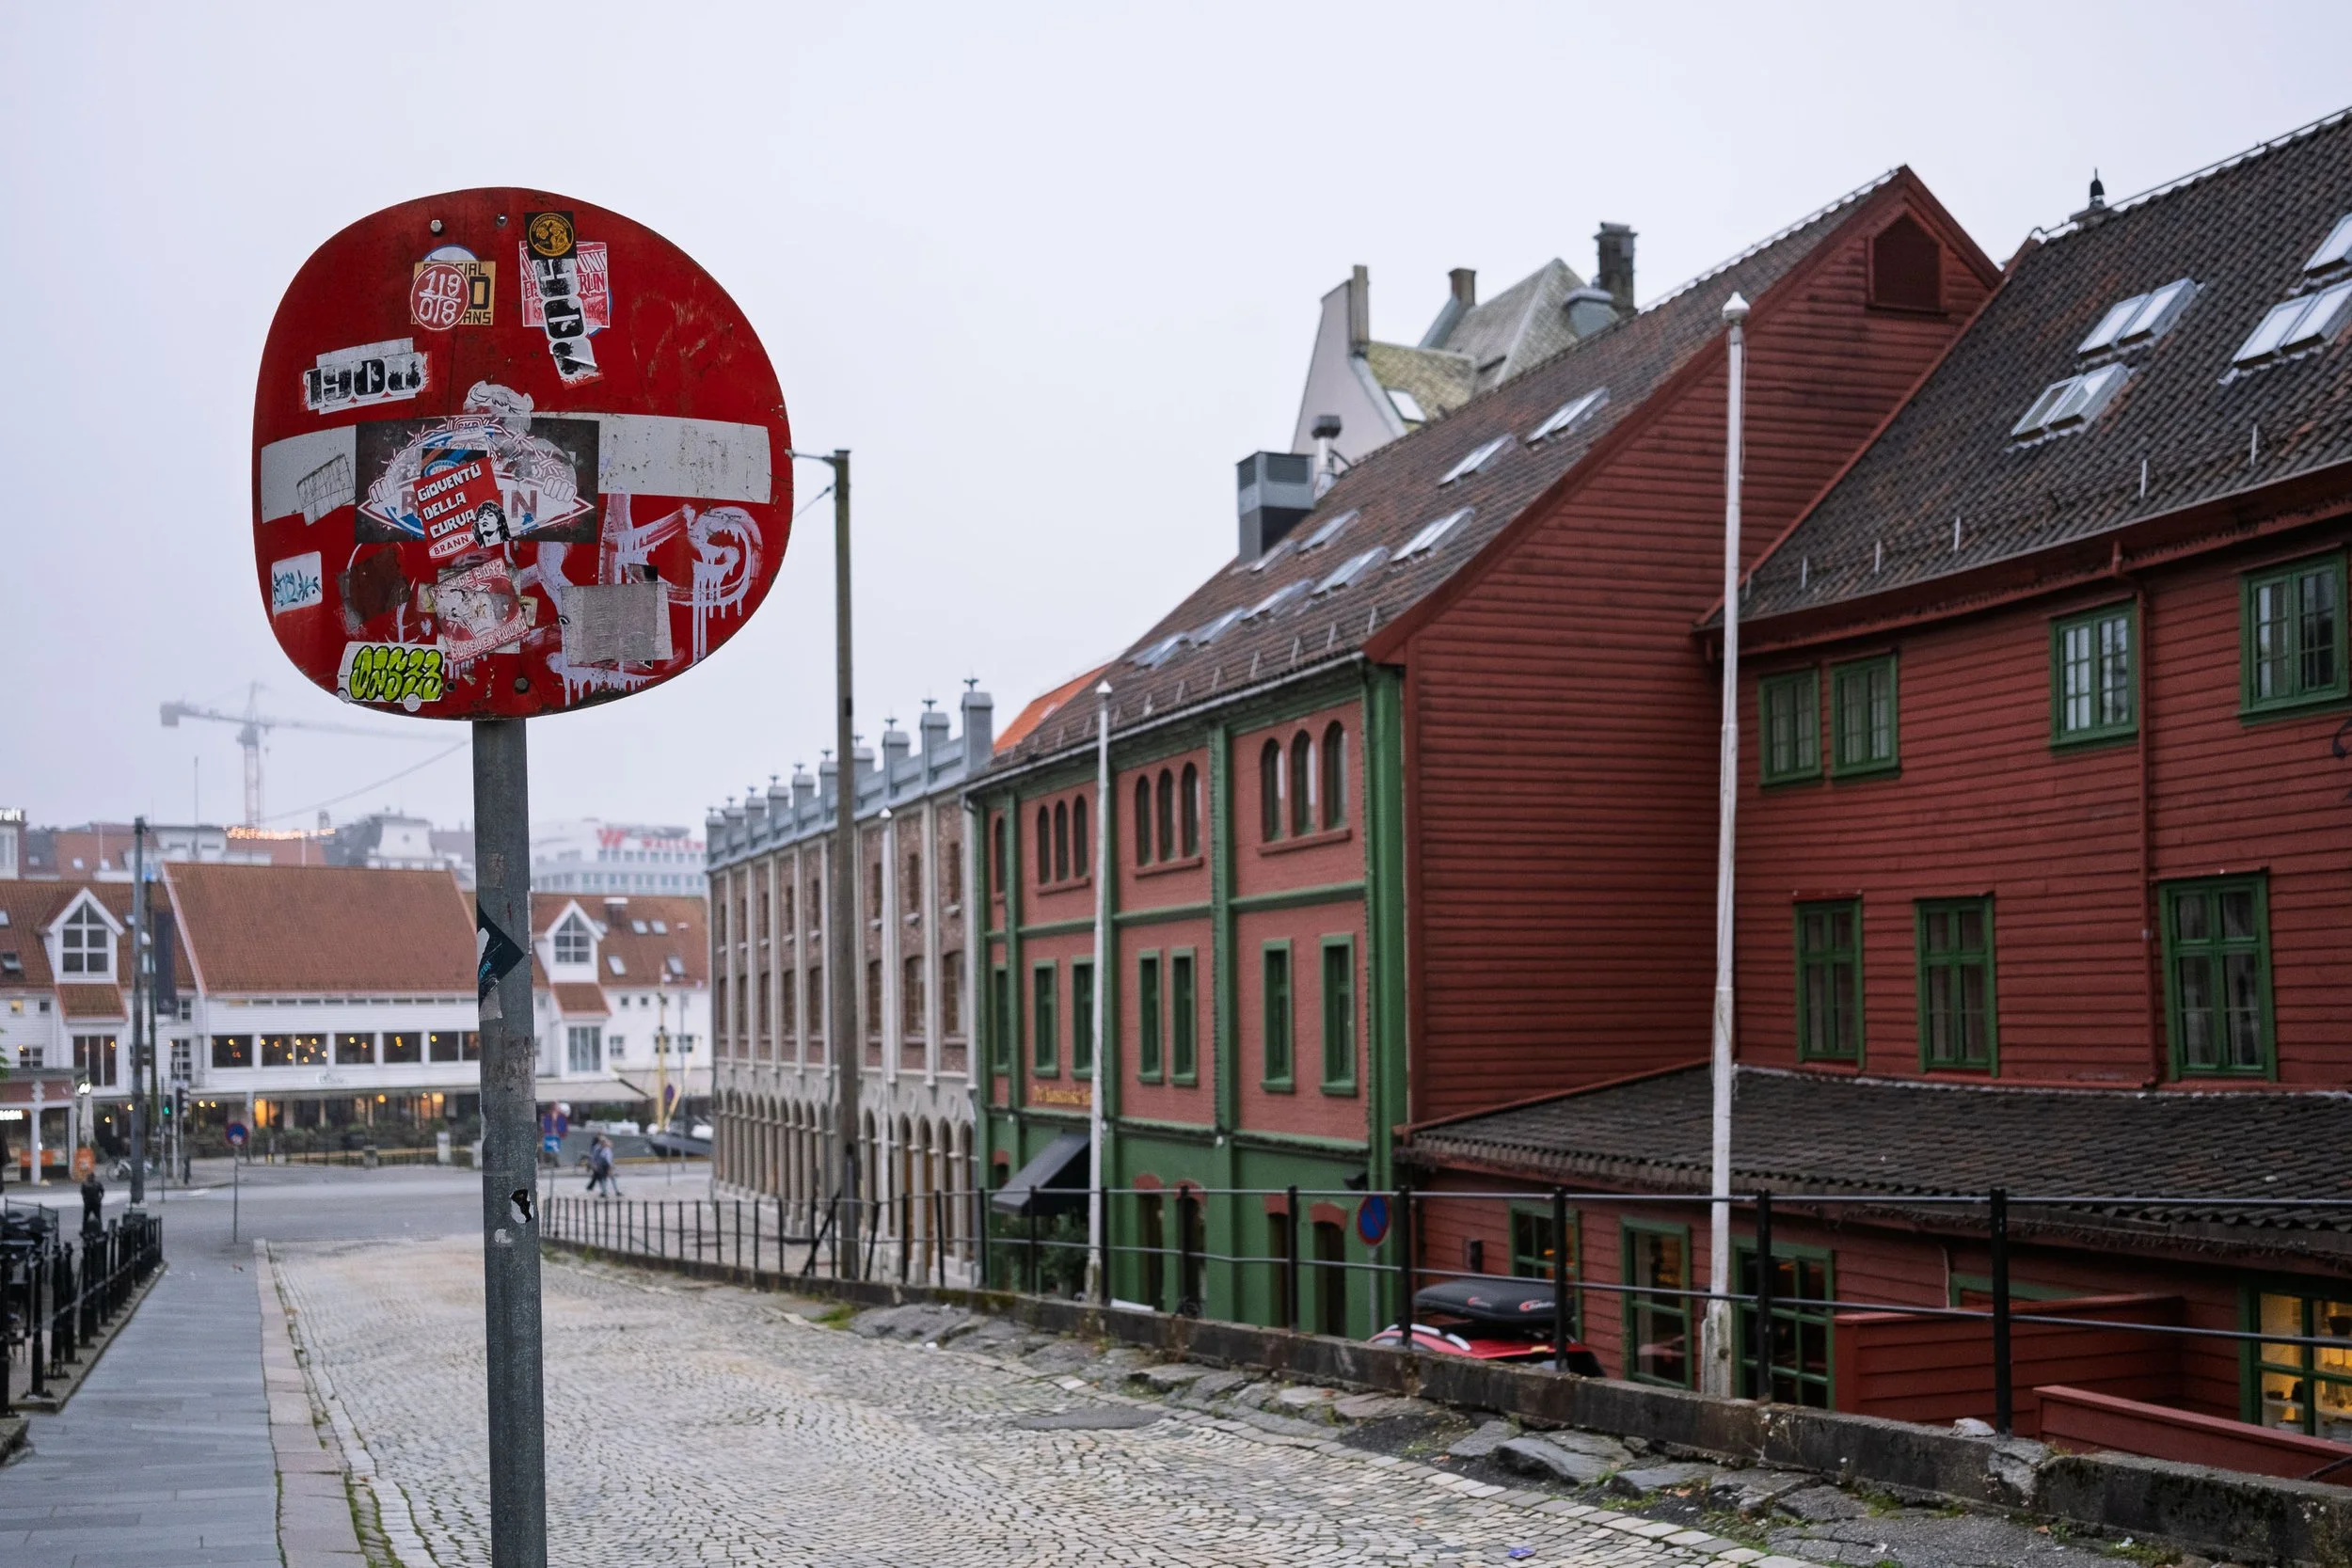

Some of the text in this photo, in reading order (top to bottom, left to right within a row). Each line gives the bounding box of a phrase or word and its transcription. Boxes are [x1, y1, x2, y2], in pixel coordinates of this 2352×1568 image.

[422, 492, 467, 520] DELLA
[430, 509, 476, 539] CURVA
[433, 535, 469, 555] BRANN
